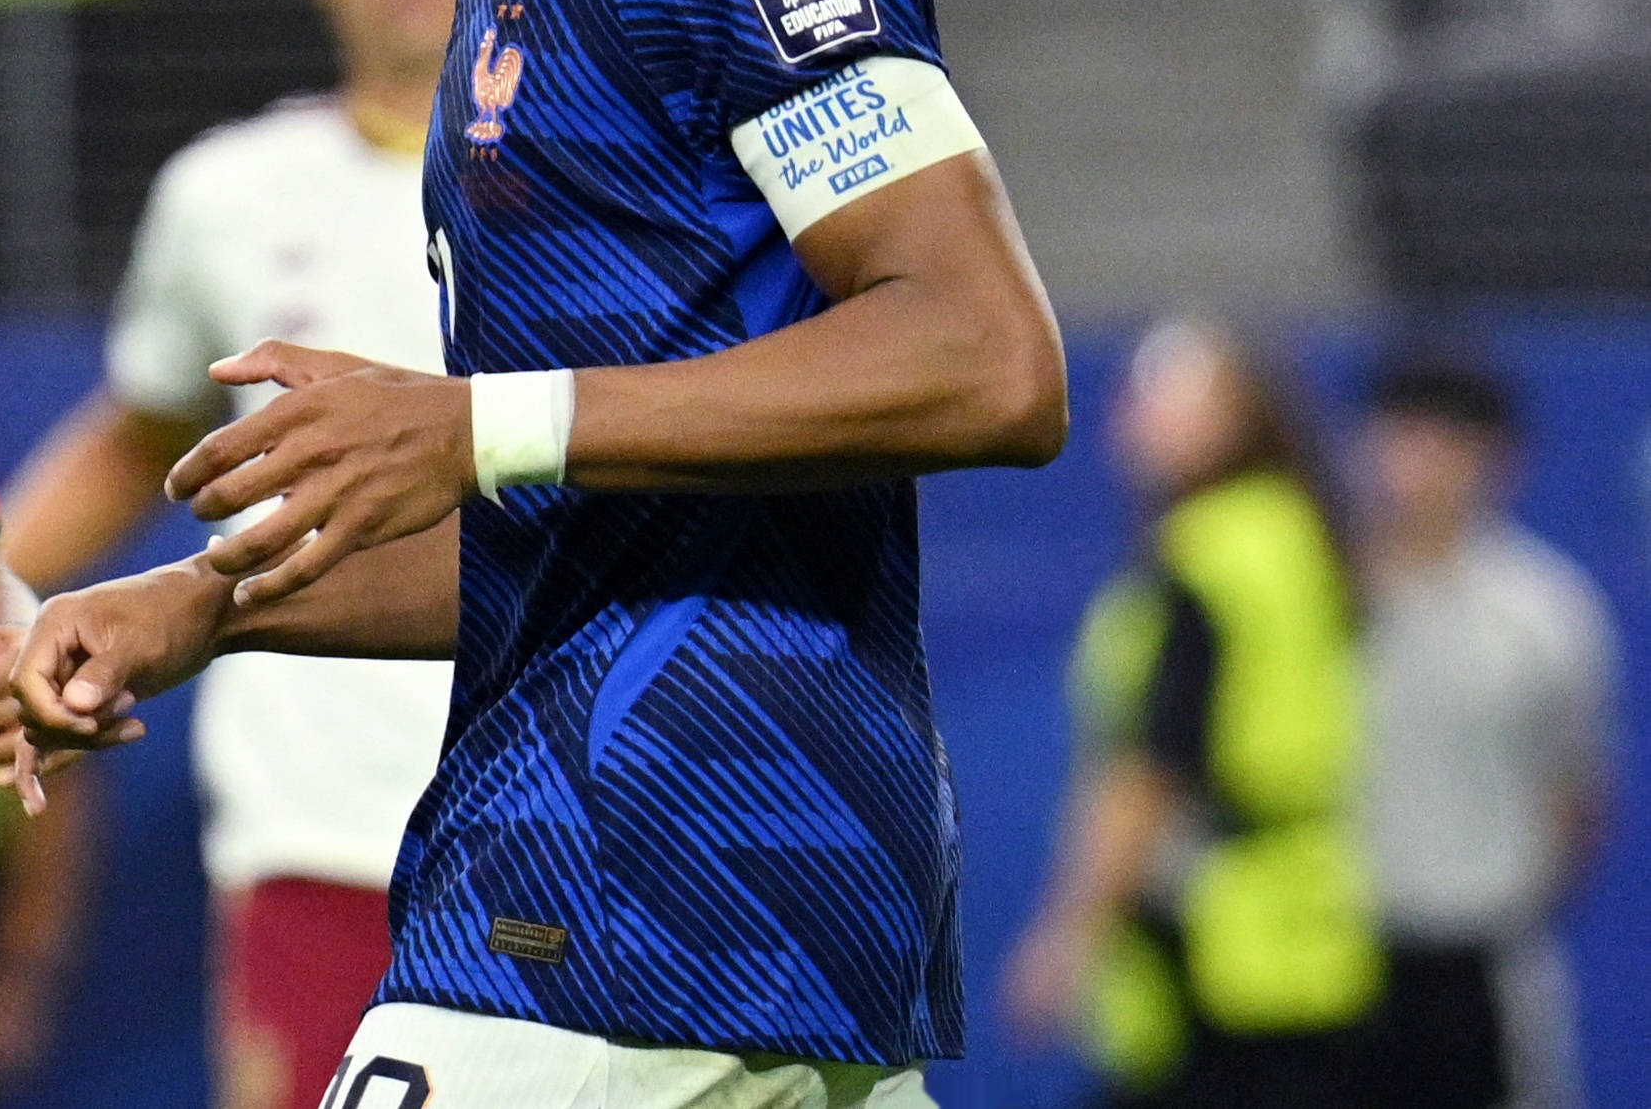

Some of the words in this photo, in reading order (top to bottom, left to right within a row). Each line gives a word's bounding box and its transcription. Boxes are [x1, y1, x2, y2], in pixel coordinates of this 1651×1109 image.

[813, 19, 847, 42] FIFA
[762, 79, 886, 158] UNITES
[778, 157, 824, 190] the
[821, 106, 913, 164] World
[831, 156, 887, 193] FIFA
